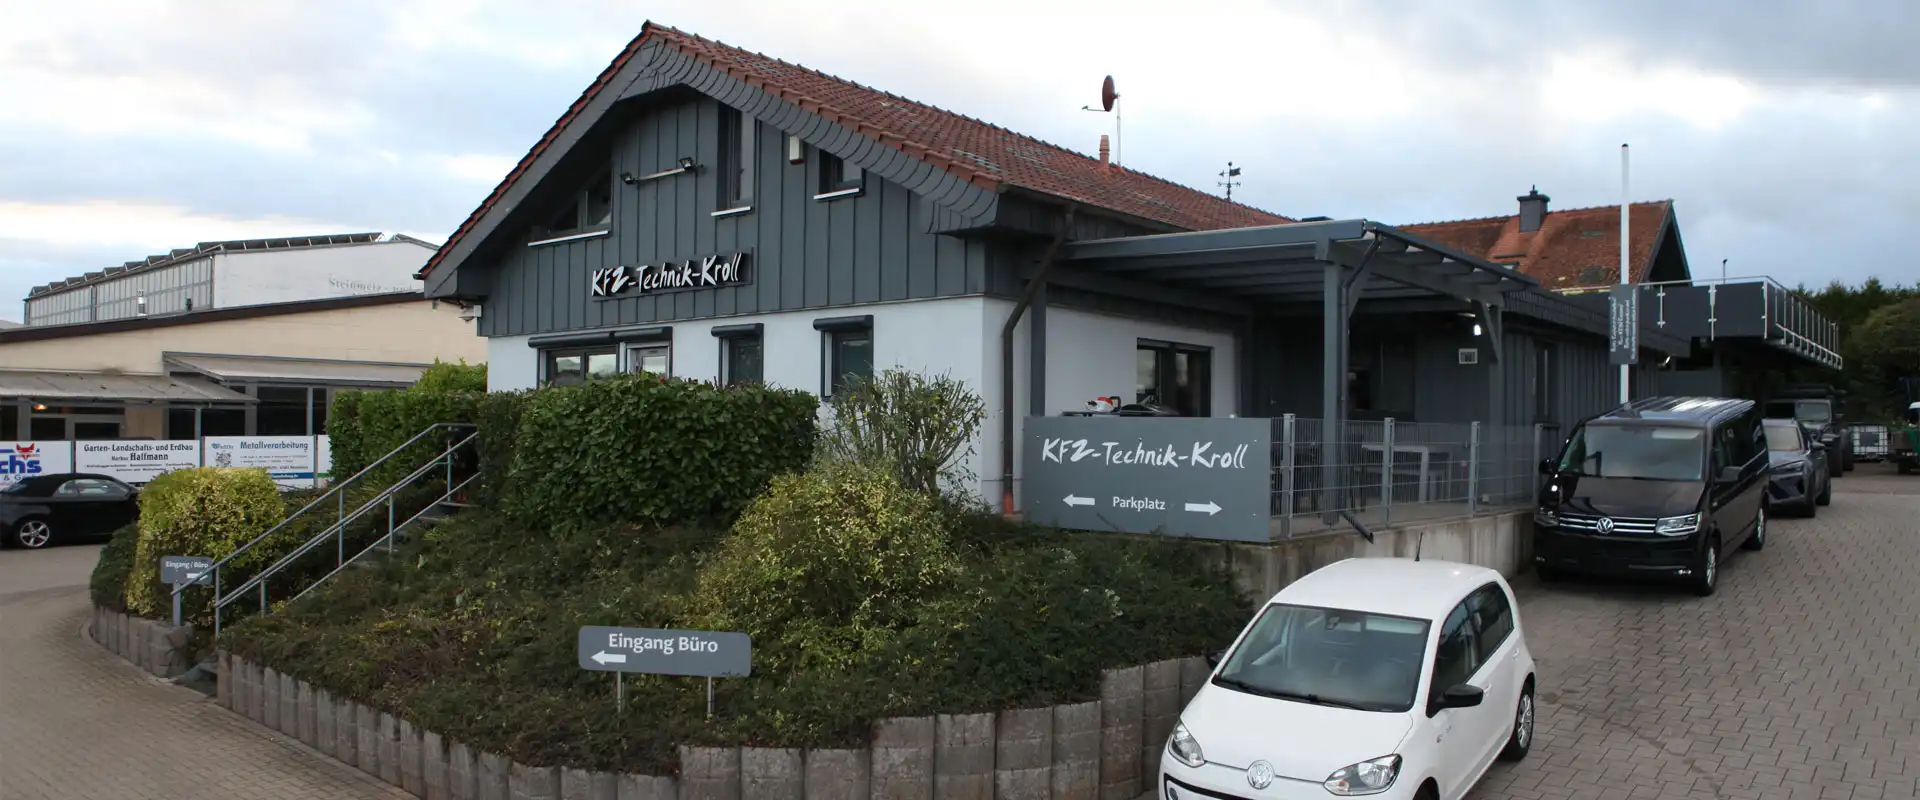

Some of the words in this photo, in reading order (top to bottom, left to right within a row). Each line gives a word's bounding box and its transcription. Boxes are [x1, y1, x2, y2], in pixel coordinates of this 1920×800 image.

[84, 444, 110, 452] Garten-
[170, 443, 193, 451] Erdbau
[240, 441, 308, 452] Metallverarbeitung
[130, 452, 169, 461] Halfmann
[1112, 496, 1166, 512] Parkplatz
[165, 561, 190, 569] Eingang
[608, 633, 674, 655] Eingang
[678, 636, 718, 653] Büro
